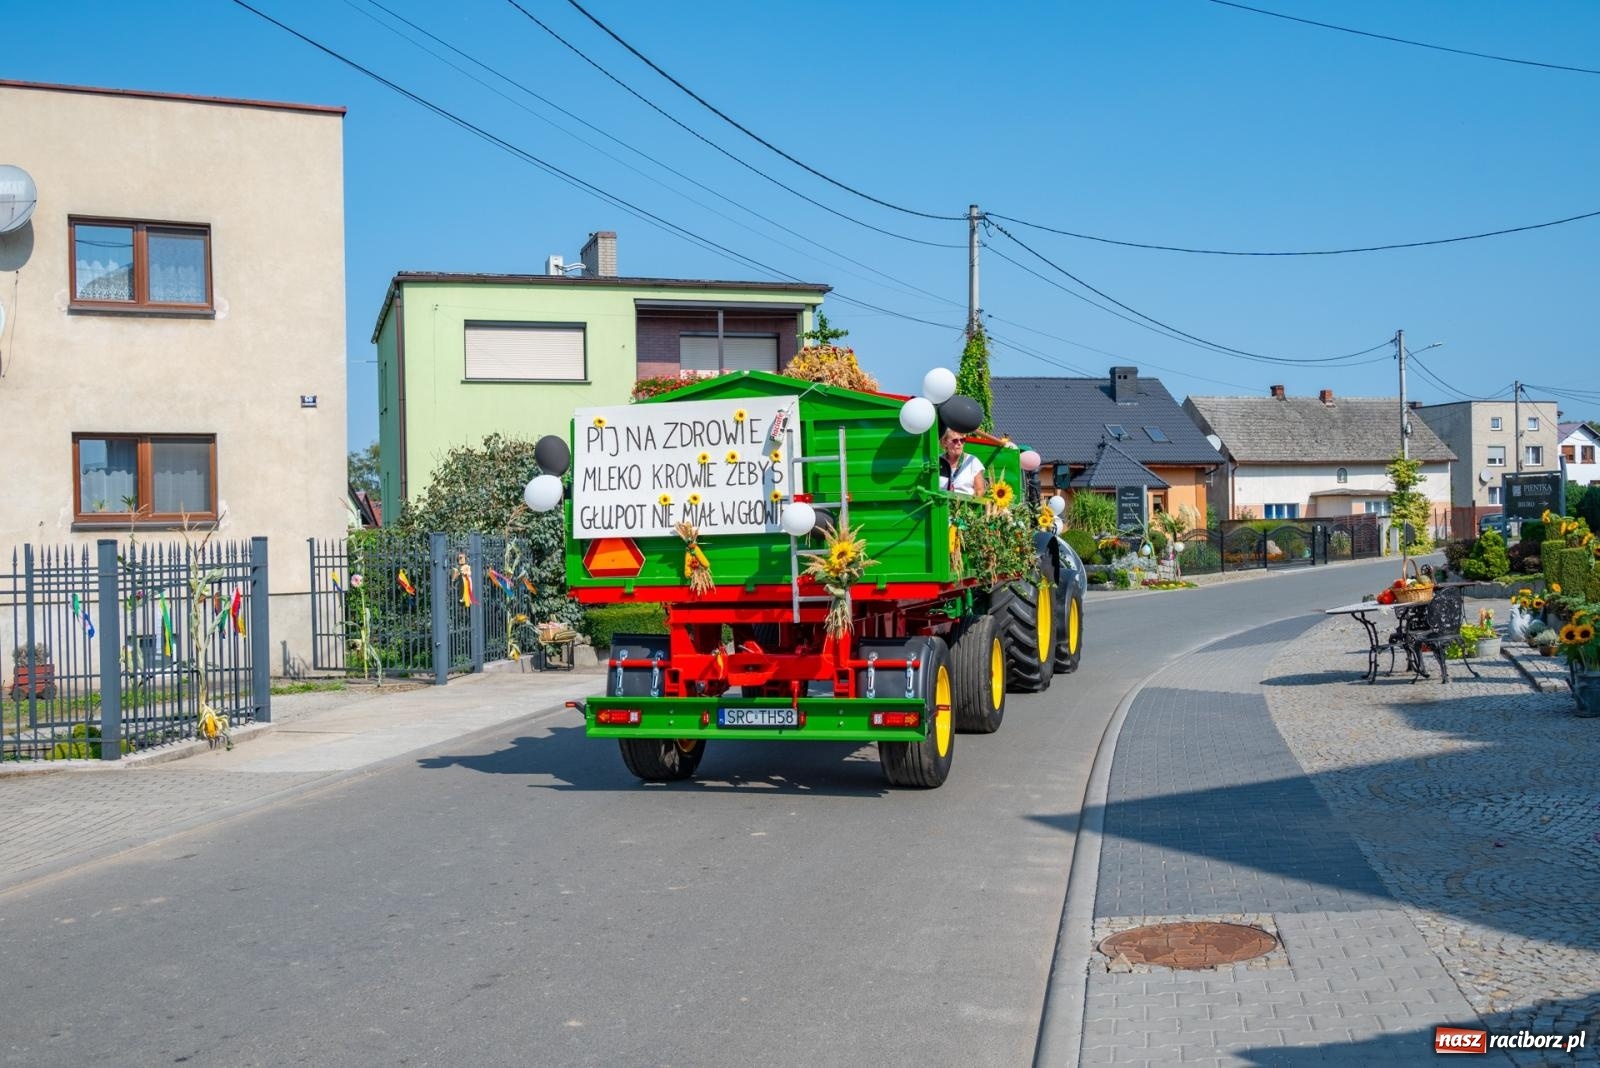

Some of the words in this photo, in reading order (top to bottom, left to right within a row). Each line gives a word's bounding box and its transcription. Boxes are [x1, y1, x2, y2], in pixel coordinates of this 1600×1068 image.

[587, 425, 619, 457] PIJ
[626, 424, 657, 452] NA
[662, 418, 763, 449] ZDROWIE
[582, 464, 642, 492] MLEKO
[652, 462, 718, 490] KROWIE
[1523, 483, 1552, 492] PIENTKA
[580, 504, 647, 530] GŁUPOT
[652, 503, 675, 528] NIE
[682, 501, 719, 527] MIAŁ
[727, 709, 754, 724] SRC
[760, 709, 795, 724] TH58
